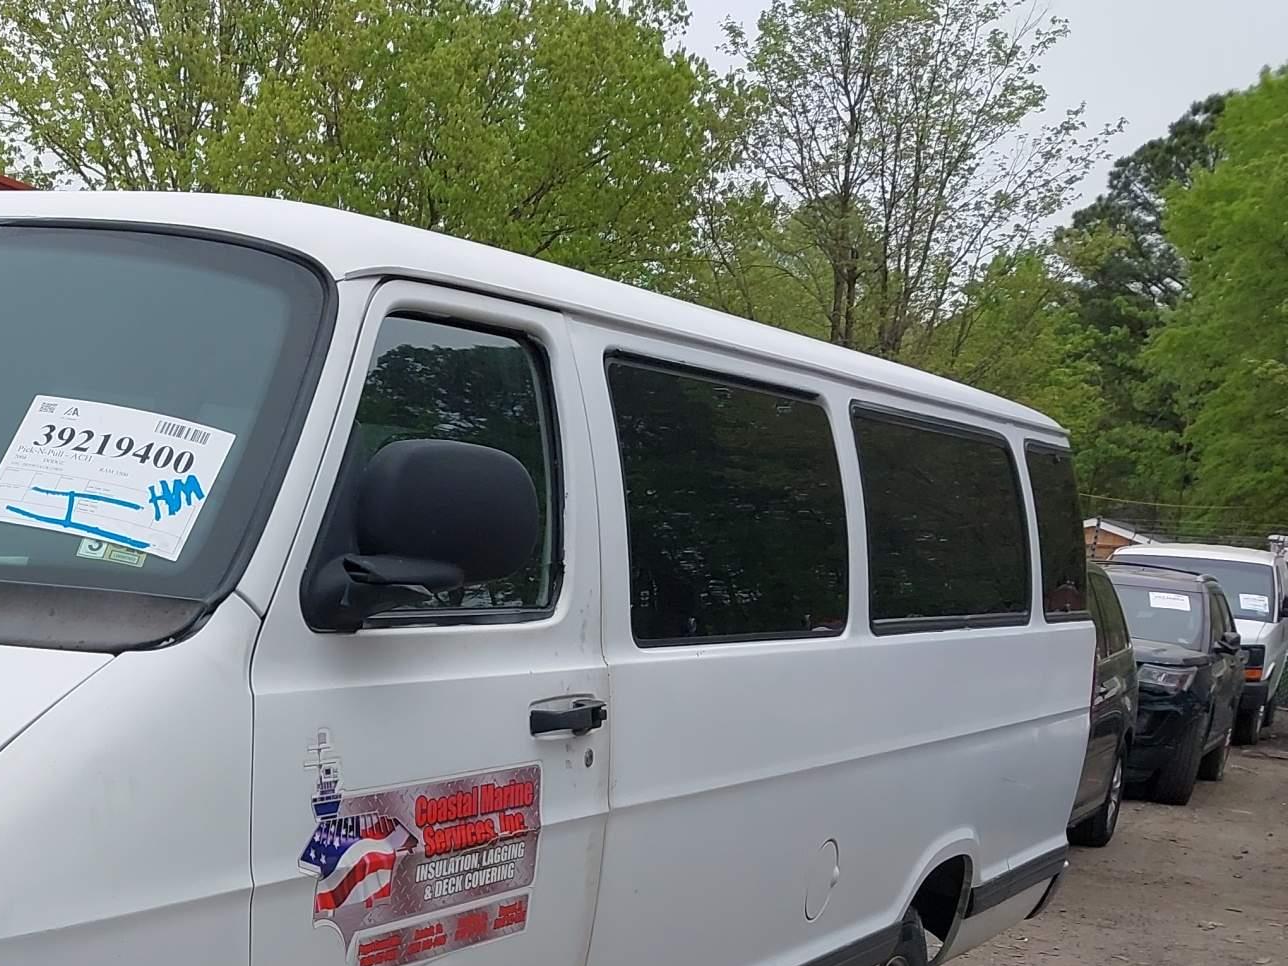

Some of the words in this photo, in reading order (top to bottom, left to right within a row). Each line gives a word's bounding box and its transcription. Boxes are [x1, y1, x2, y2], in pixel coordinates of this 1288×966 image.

[32, 423, 195, 474] 39219400
[415, 785, 479, 829] Coastal
[480, 780, 535, 816] Marine
[415, 850, 480, 883] INSULATION,
[481, 841, 526, 864] LAGGING
[423, 885, 433, 901] &
[434, 874, 464, 898] DECK
[464, 862, 516, 891] COVERING
